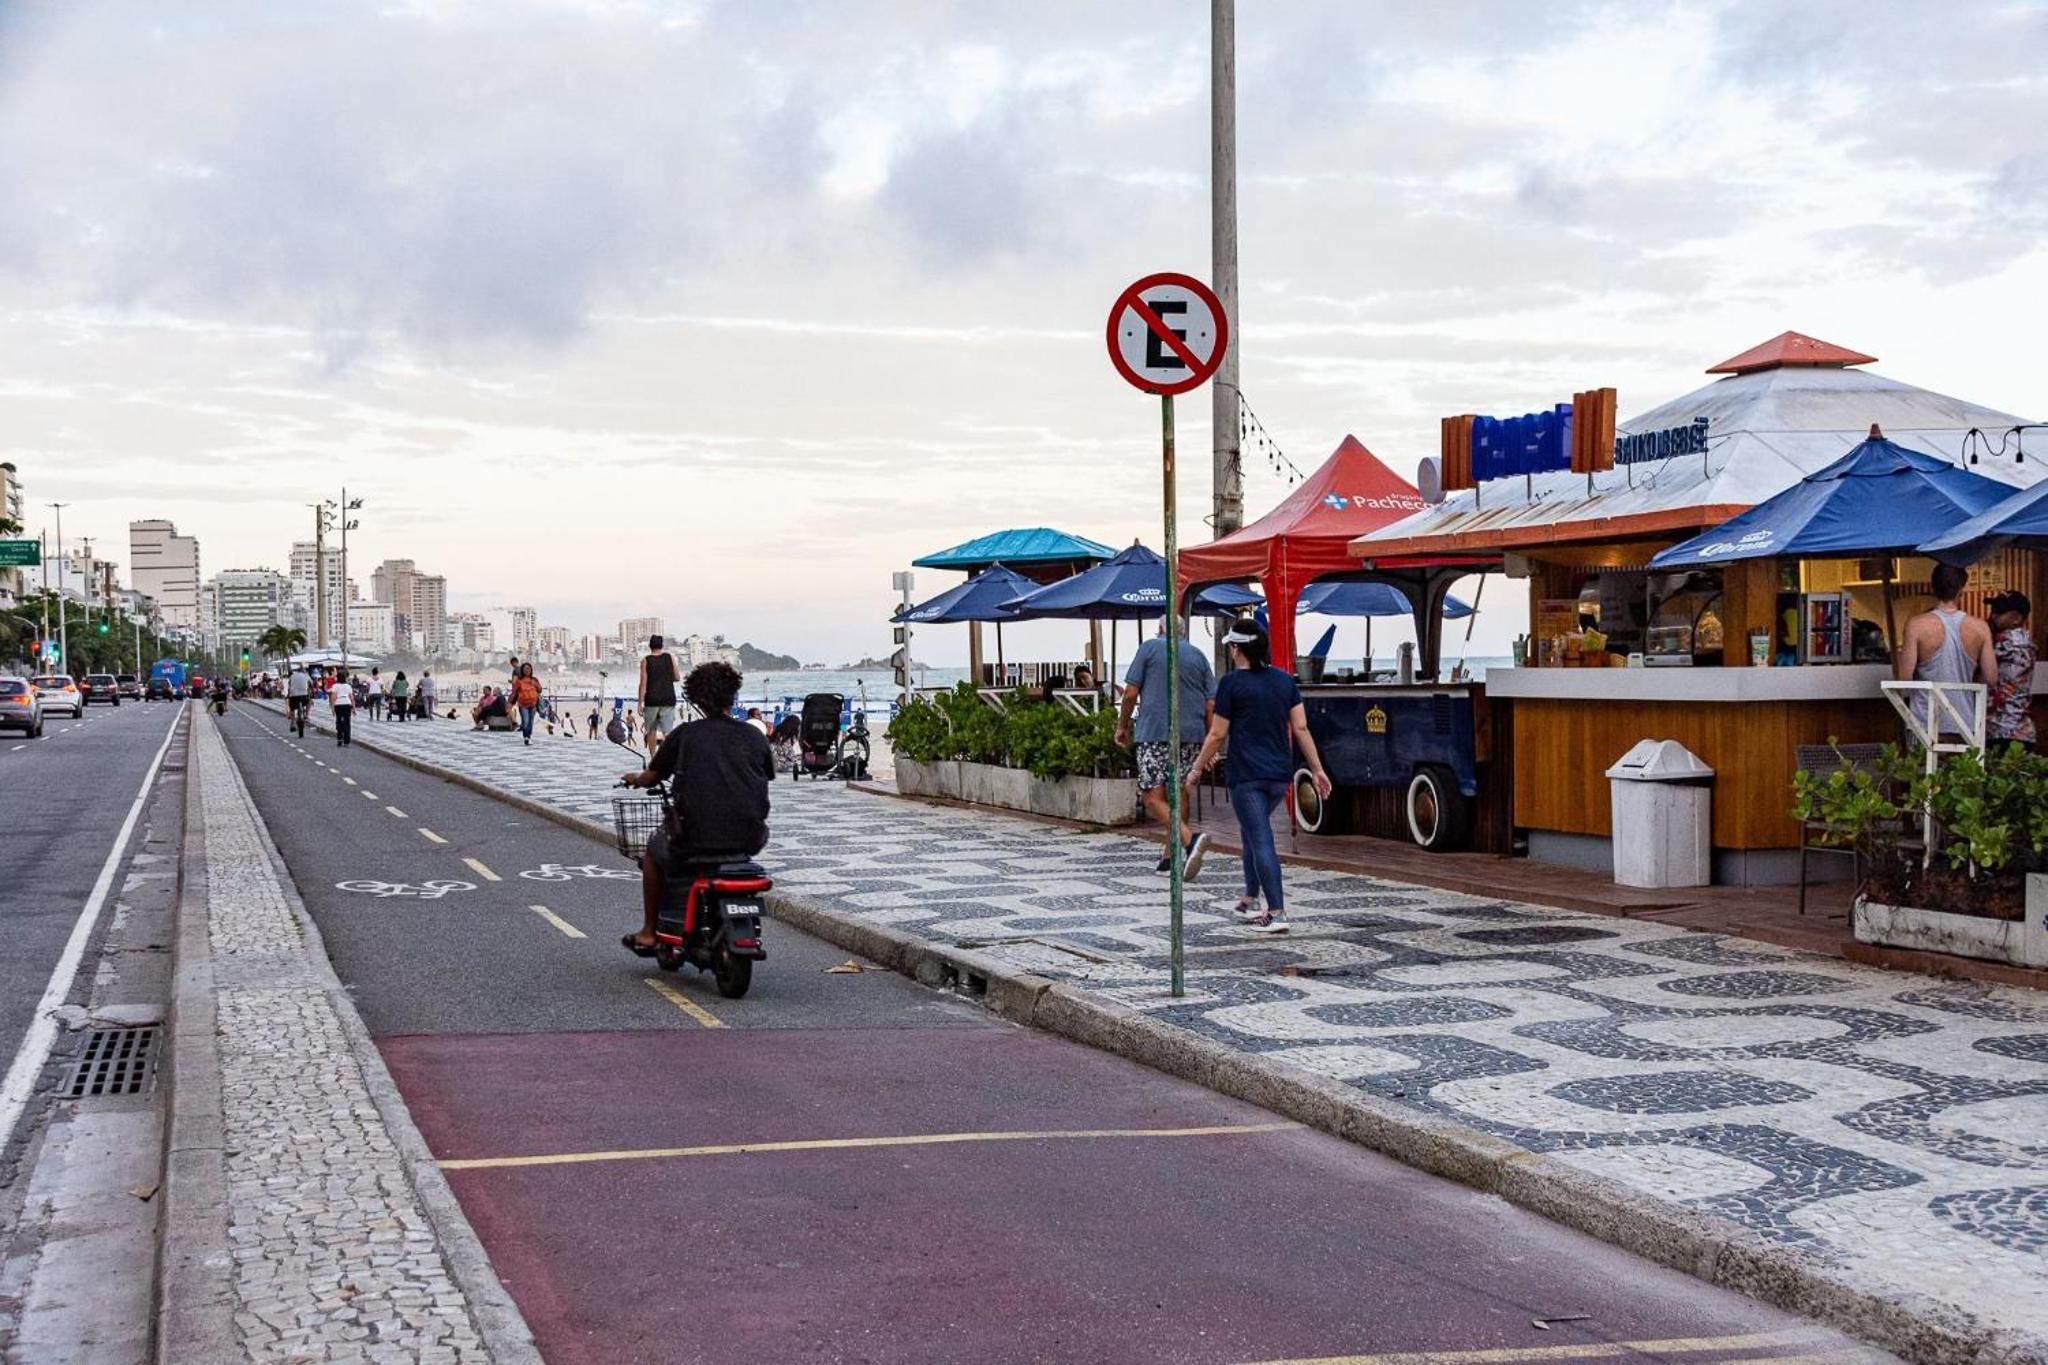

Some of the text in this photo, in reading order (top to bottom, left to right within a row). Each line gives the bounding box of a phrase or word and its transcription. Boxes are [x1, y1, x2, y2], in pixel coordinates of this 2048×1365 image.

[1146, 301, 1187, 368] E
[1352, 495, 1432, 510] Pacheco
[1122, 593, 1167, 603] Coron
